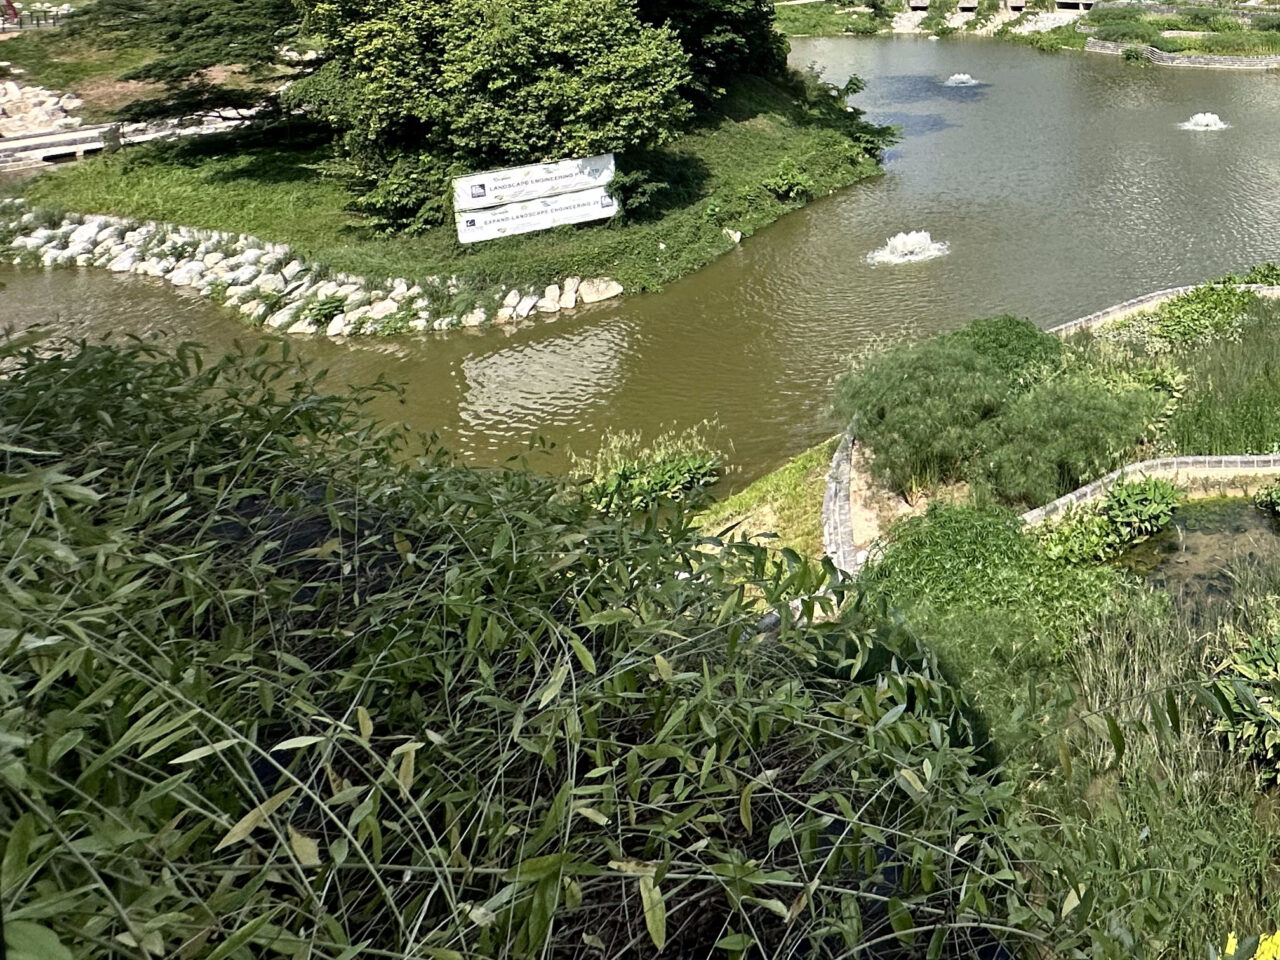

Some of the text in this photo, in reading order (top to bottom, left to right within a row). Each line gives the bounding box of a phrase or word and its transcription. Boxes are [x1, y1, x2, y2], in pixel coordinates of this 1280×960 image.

[489, 180, 529, 192] LANDSCAPE
[530, 173, 574, 184] ENGINEERING
[551, 202, 591, 213] ENGINEERING
